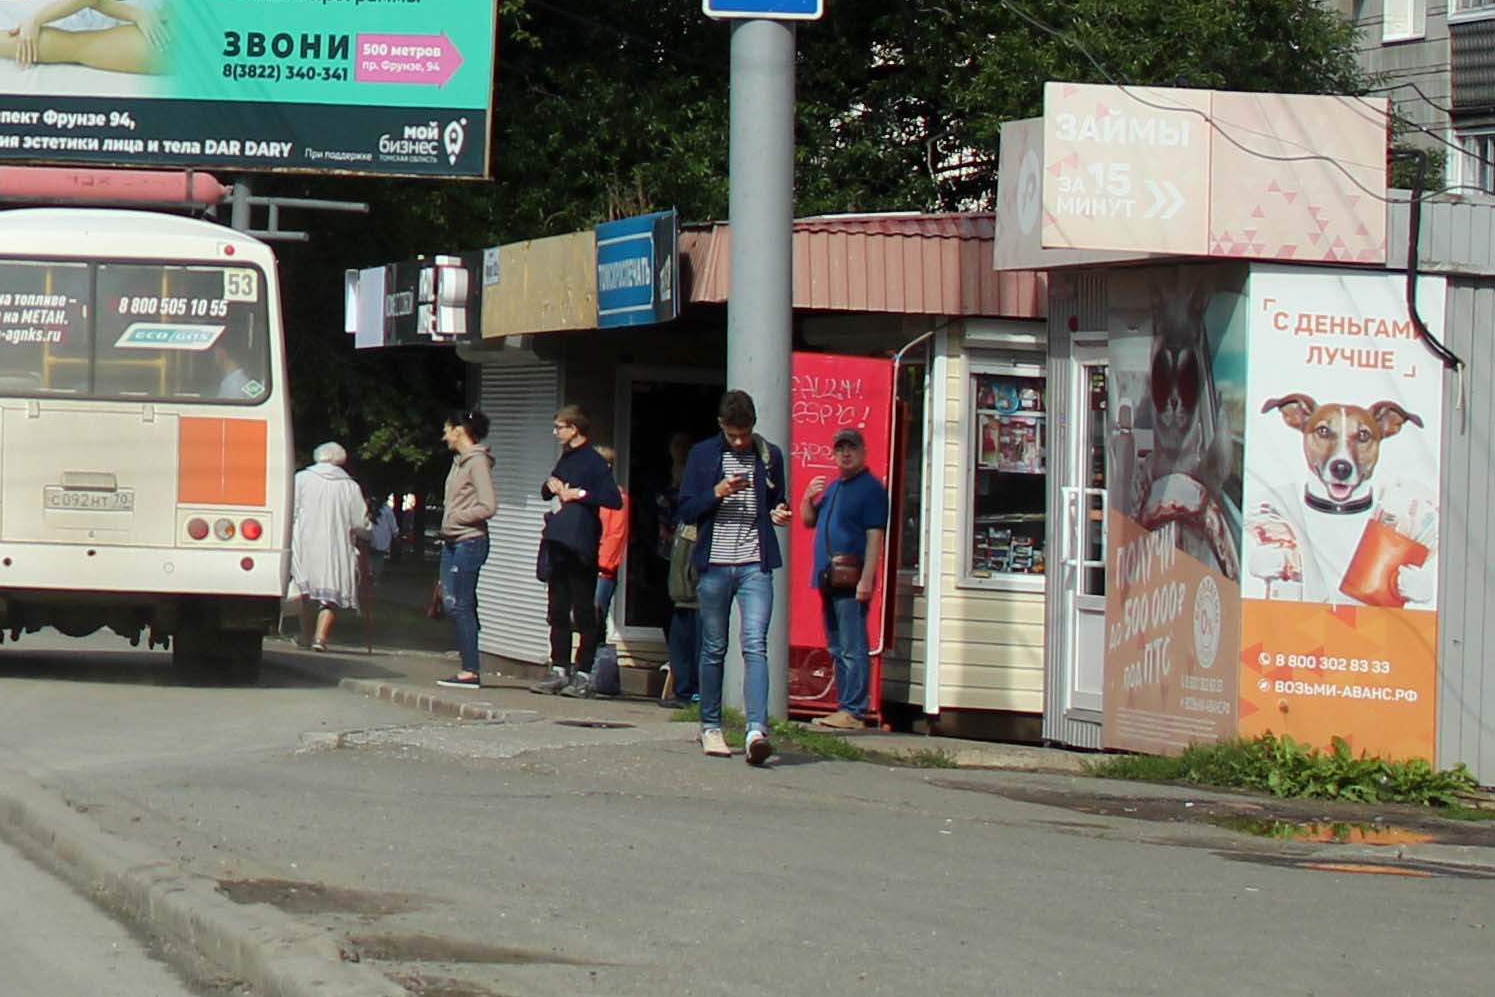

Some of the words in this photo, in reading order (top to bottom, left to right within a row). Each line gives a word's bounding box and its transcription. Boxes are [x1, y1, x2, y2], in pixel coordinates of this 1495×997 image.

[223, 31, 350, 60] ЗВОНИ
[363, 43, 388, 56] 500
[390, 46, 441, 59] метров
[222, 64, 281, 82] 8(3822)
[286, 66, 348, 81] 340-341
[362, 62, 378, 72] пр.
[380, 61, 425, 73] Фрунзе,
[427, 62, 441, 72] 94
[42, 110, 105, 128] Фрунзе
[109, 112, 136, 130] 94,
[1055, 108, 1191, 146] ЗАЙМЫ
[404, 122, 439, 139] мой
[22, 135, 99, 150] эстетики
[102, 138, 143, 153] лица
[147, 140, 159, 152] и
[163, 140, 201, 154] тела
[204, 140, 240, 156] DAR
[244, 141, 292, 158] DARY
[379, 134, 438, 154] бизнес
[304, 147, 322, 160] При
[325, 150, 372, 162] поддержке
[1057, 177, 1086, 193] ЗА
[1088, 162, 1130, 195] 15
[1057, 197, 1136, 218] МИНУТ
[228, 273, 252, 296] 53
[14, 294, 67, 306] топливе
[118, 297, 129, 314] 8
[130, 297, 158, 314] 800
[160, 298, 187, 315] 505
[191, 299, 207, 316] 10
[209, 299, 229, 317] 55
[3, 311, 18, 323] на
[21, 310, 69, 325] МЕТАН.
[1274, 312, 1289, 331] С
[1306, 346, 1394, 370] ЛУЧШЕ
[1116, 520, 1176, 590] ПОЛУЧИ
[1144, 634, 1172, 685] ПТС
[1276, 654, 1285, 666] 8
[1288, 655, 1316, 668] 800
[1319, 657, 1347, 671] 302
[1350, 659, 1368, 672] 83
[1372, 661, 1390, 674] 33
[1274, 680, 1418, 702] ВОЗЬМИ-АВАНС.РФ
